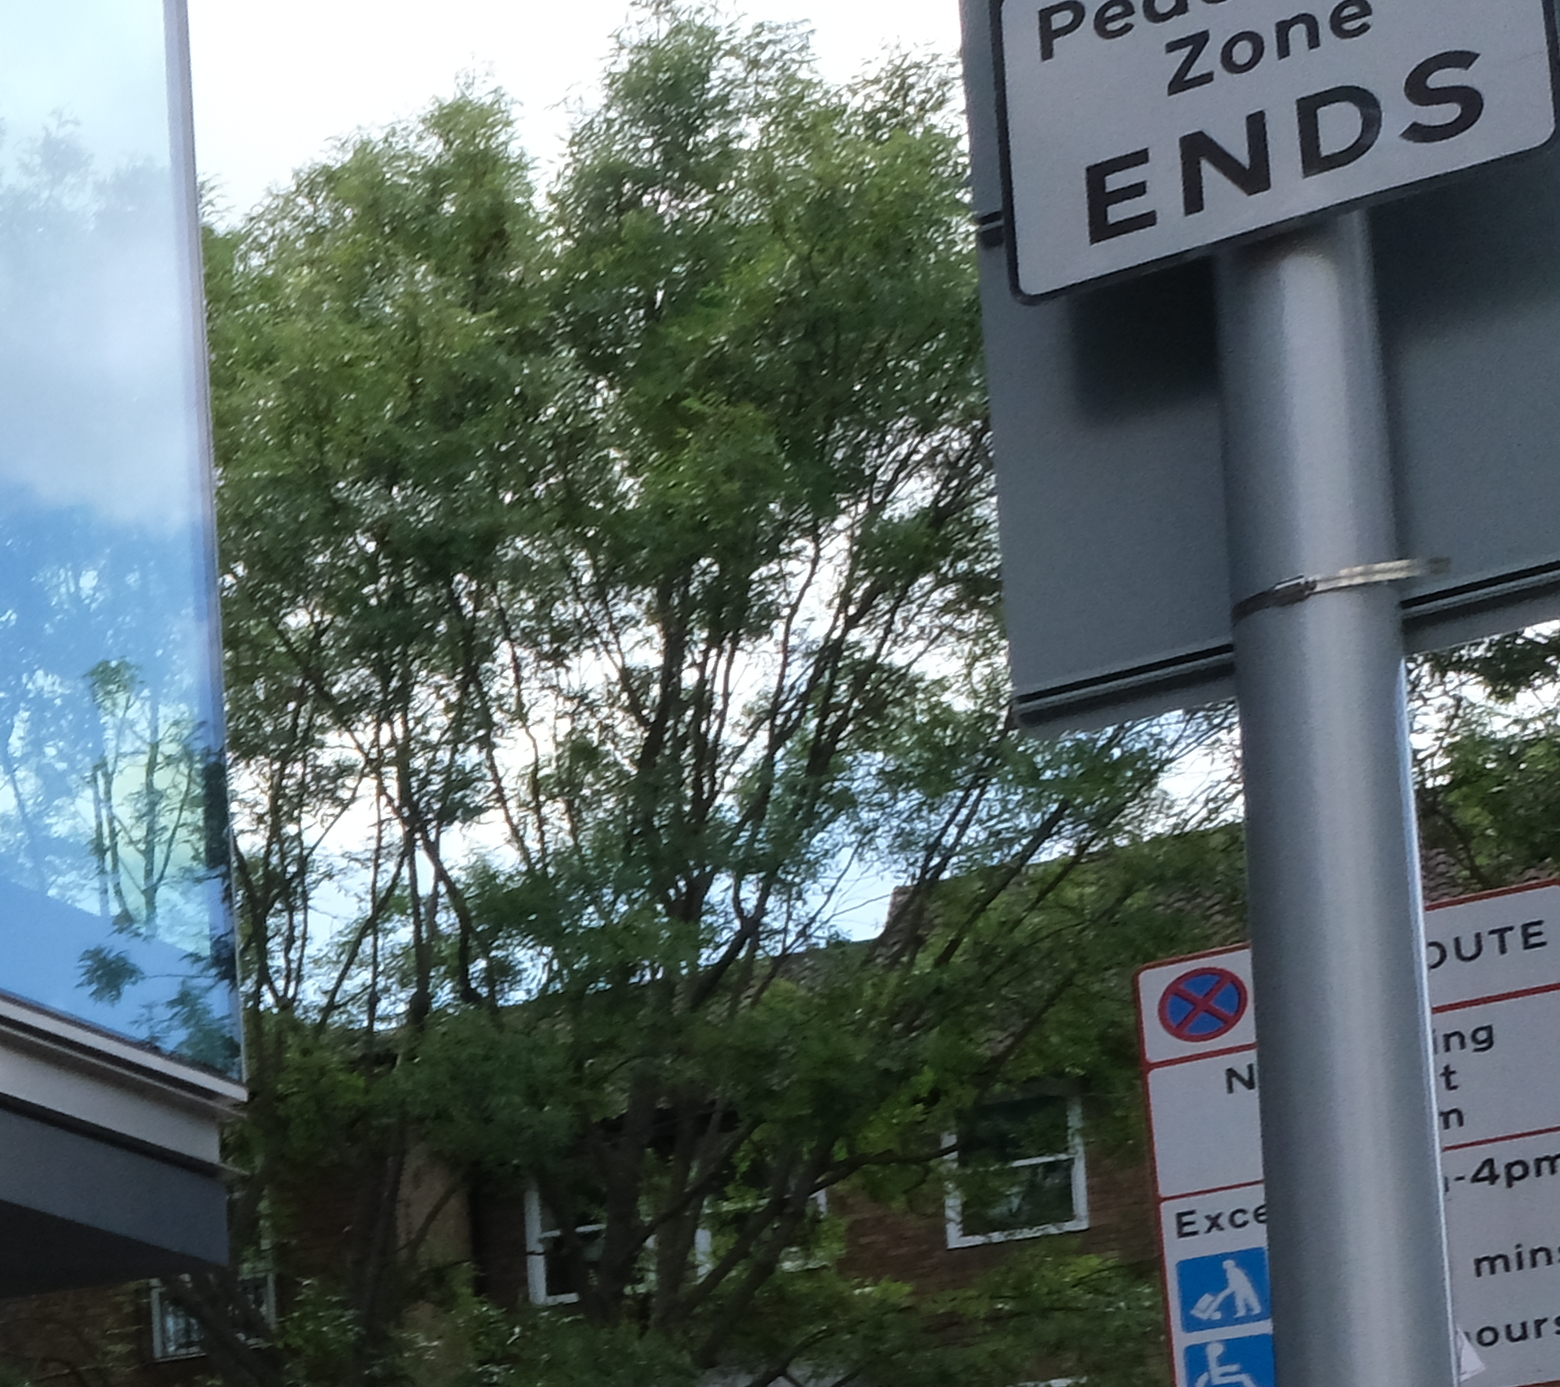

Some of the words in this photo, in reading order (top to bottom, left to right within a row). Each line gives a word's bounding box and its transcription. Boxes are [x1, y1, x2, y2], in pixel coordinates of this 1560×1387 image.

[1165, 0, 1373, 97] Zone
[1086, 50, 1484, 246] ENDS
[1443, 1152, 1560, 1193] -4pm
[1473, 1243, 1560, 1278] min
